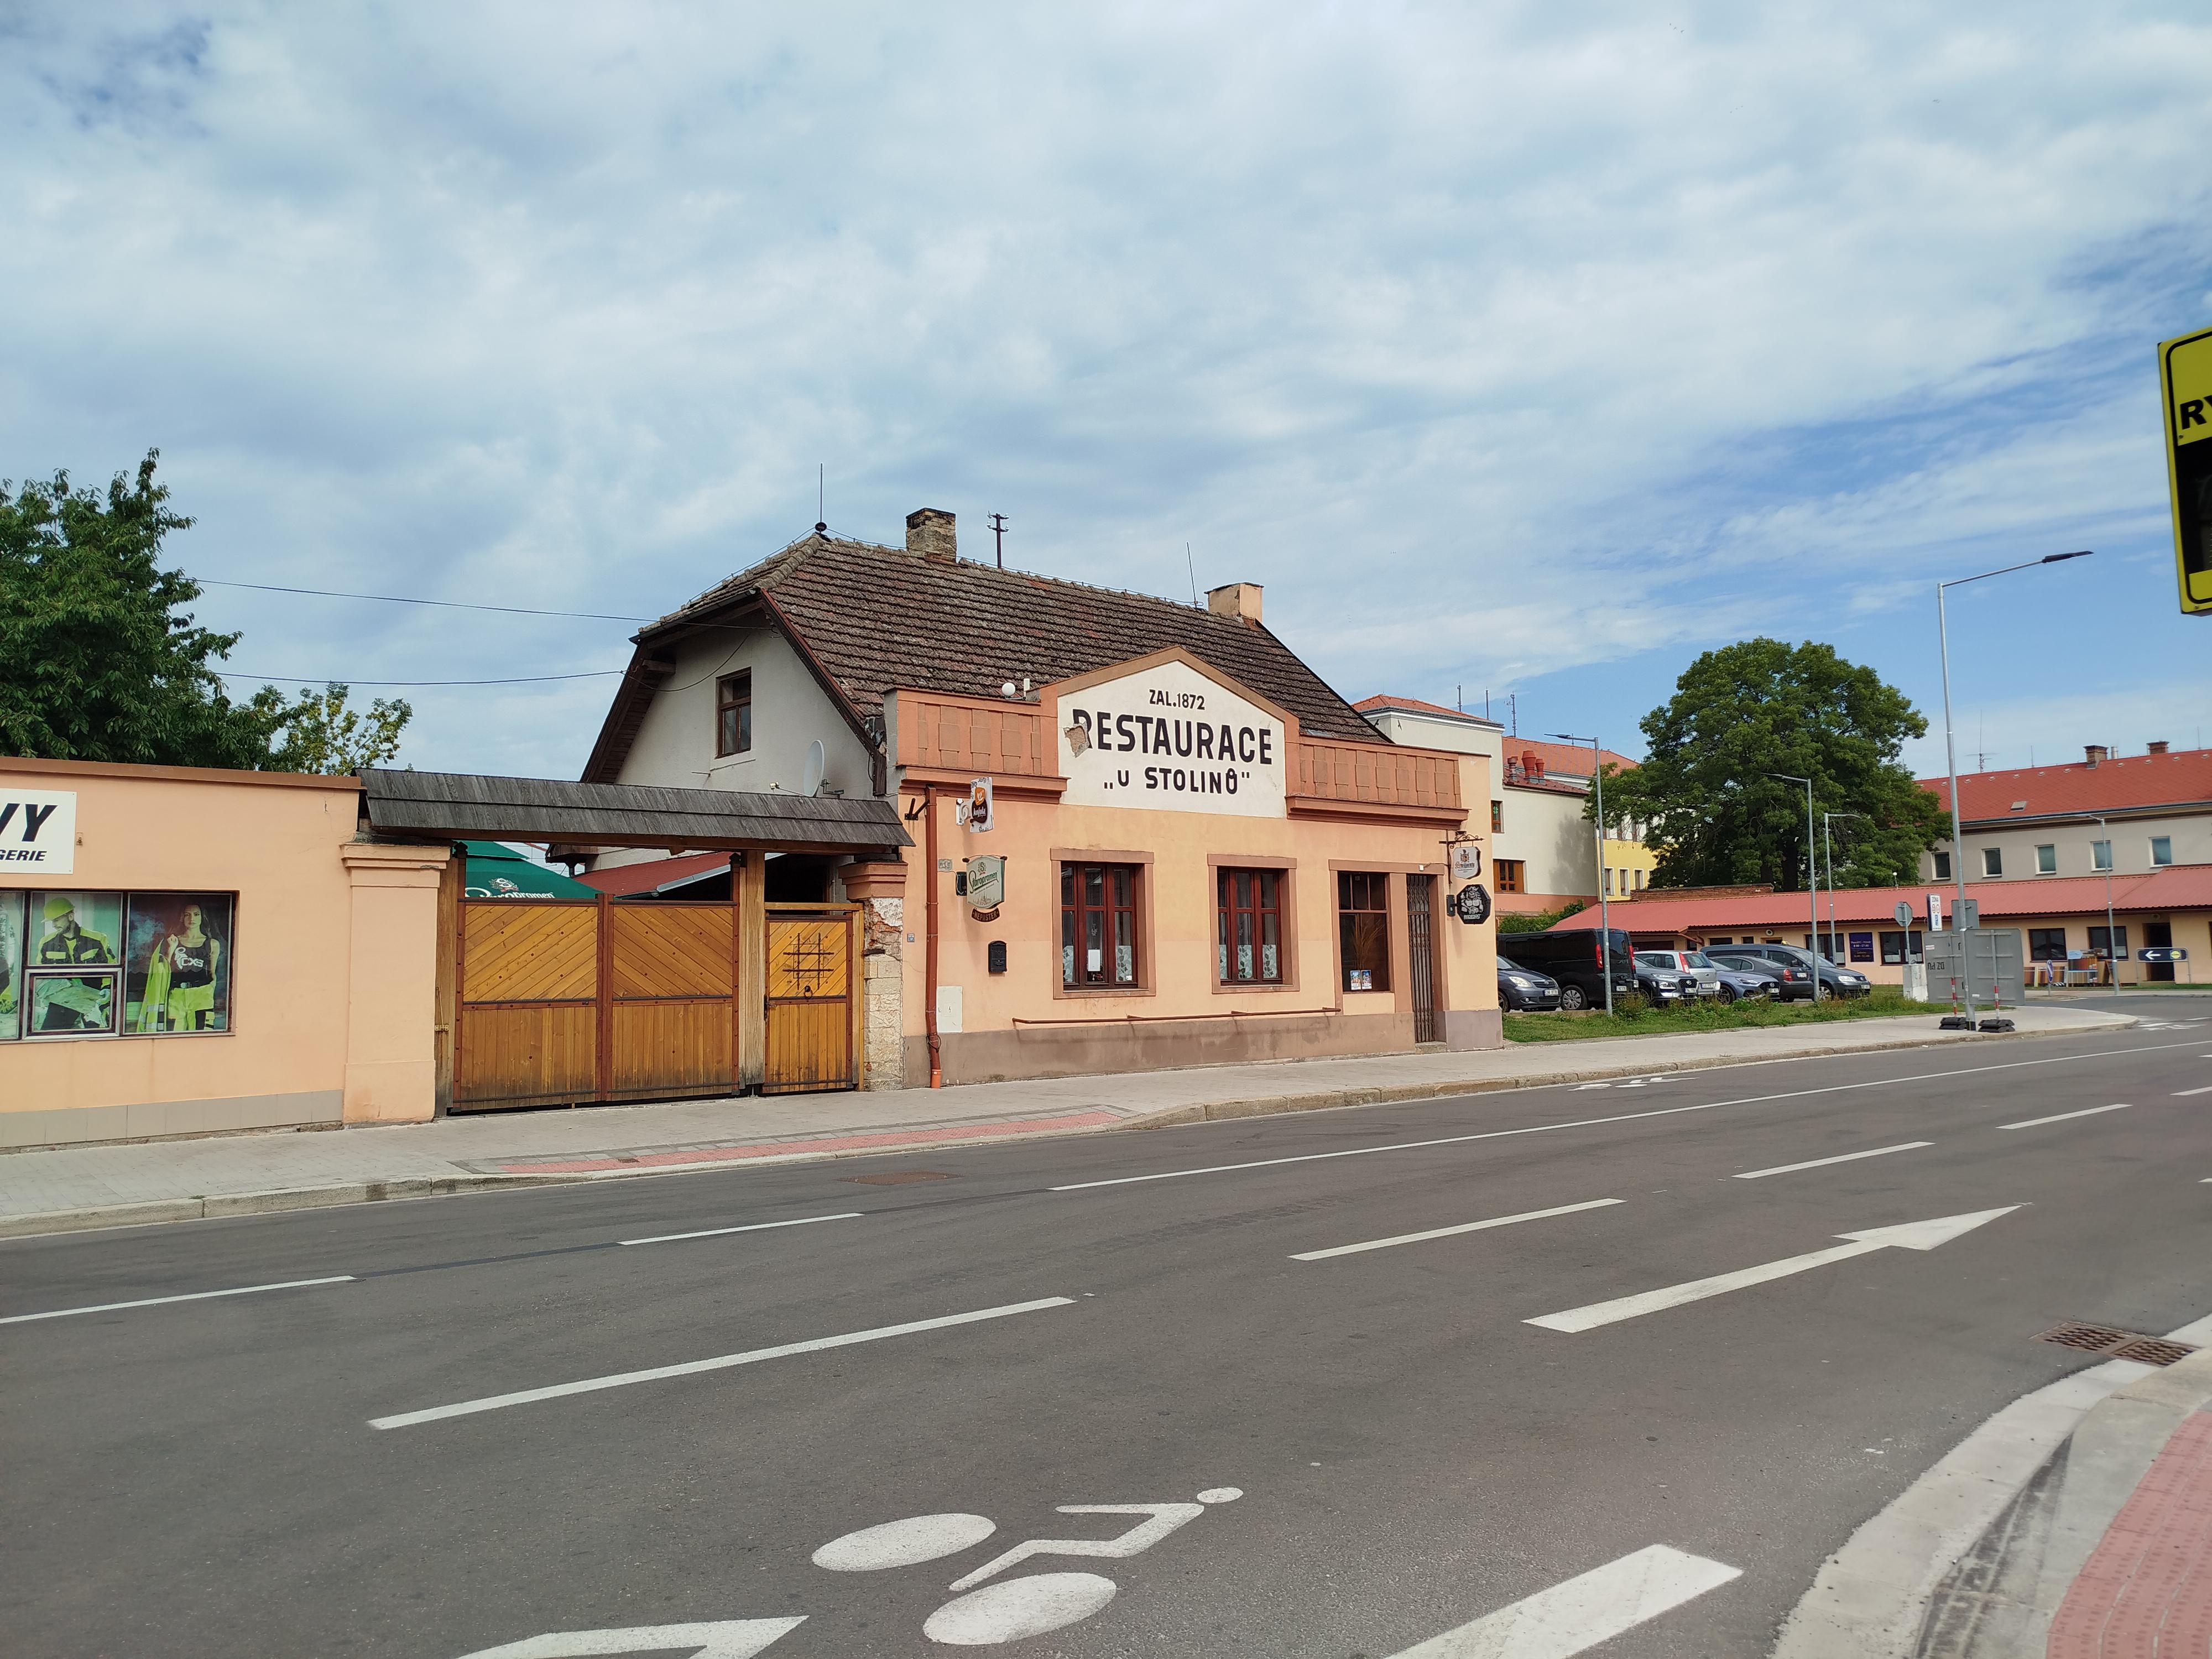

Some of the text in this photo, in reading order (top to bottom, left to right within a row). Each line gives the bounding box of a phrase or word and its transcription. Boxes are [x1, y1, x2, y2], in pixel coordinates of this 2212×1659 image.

[2180, 395, 2212, 430] R
[1149, 689, 1206, 711] ZAL.1872
[1072, 708, 1272, 765] RESTAURACE
[968, 870, 998, 894] Staropramen
[974, 910, 998, 921] NEPASTER
[181, 957, 204, 968] CXS
